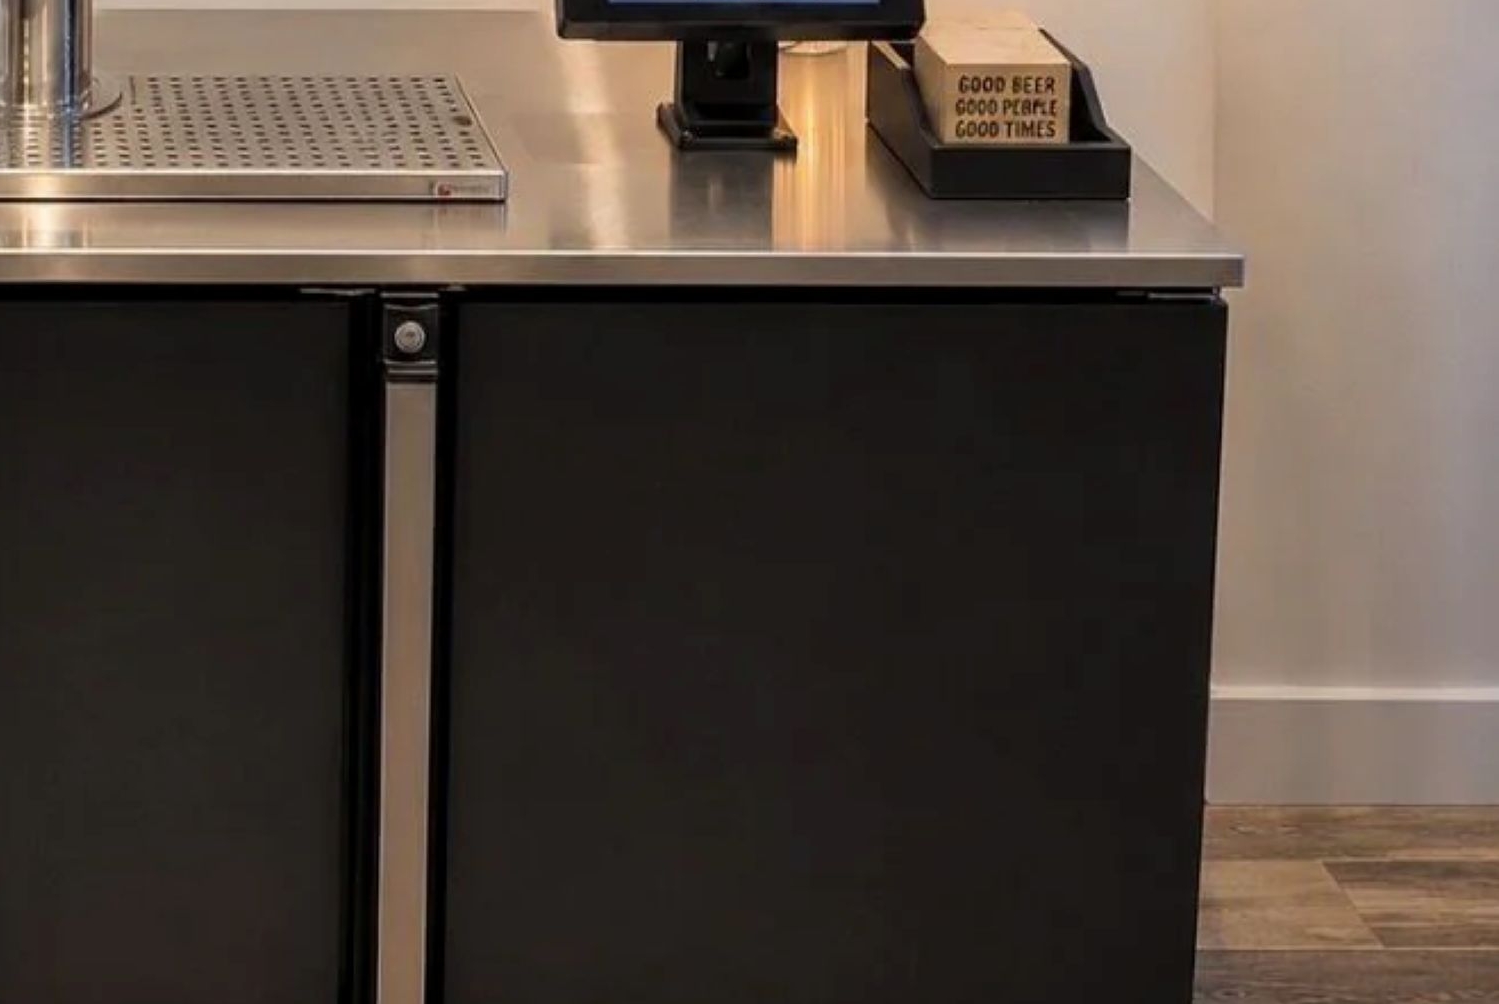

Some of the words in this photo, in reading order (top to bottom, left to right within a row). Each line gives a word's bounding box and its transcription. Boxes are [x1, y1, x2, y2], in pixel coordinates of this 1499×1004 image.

[958, 75, 1006, 94] GOOD
[1012, 76, 1055, 95] BEER
[955, 97, 998, 116] GOOD
[955, 120, 1000, 138] GOOD
[1005, 120, 1056, 138] TIMES
